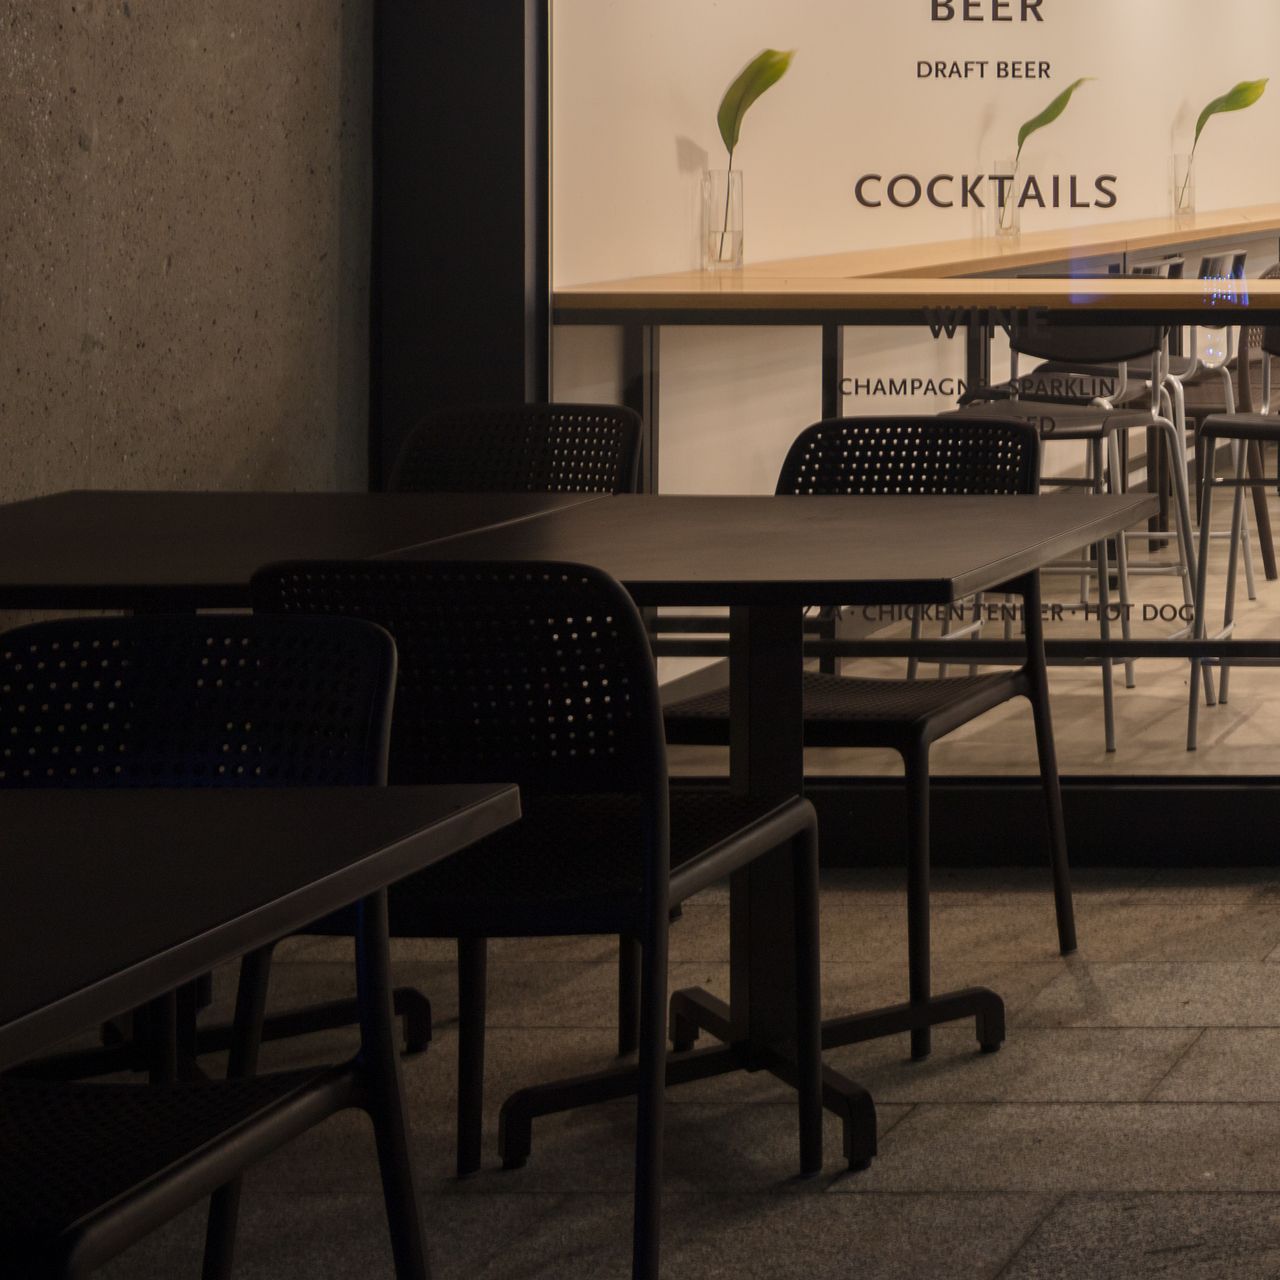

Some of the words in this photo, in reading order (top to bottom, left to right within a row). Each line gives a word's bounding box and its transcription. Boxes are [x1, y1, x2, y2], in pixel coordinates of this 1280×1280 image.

[917, 61, 988, 78] DRAFT
[997, 61, 1051, 79] BEER
[855, 174, 1118, 208] COCKTAILS
[922, 305, 1049, 339] WINE
[839, 377, 991, 396] CHAMPAGNE
[863, 603, 965, 622] CHICKEN
[973, 603, 1063, 622] TENER
[1084, 604, 1135, 622] HOT
[1142, 604, 1195, 623] DOG
